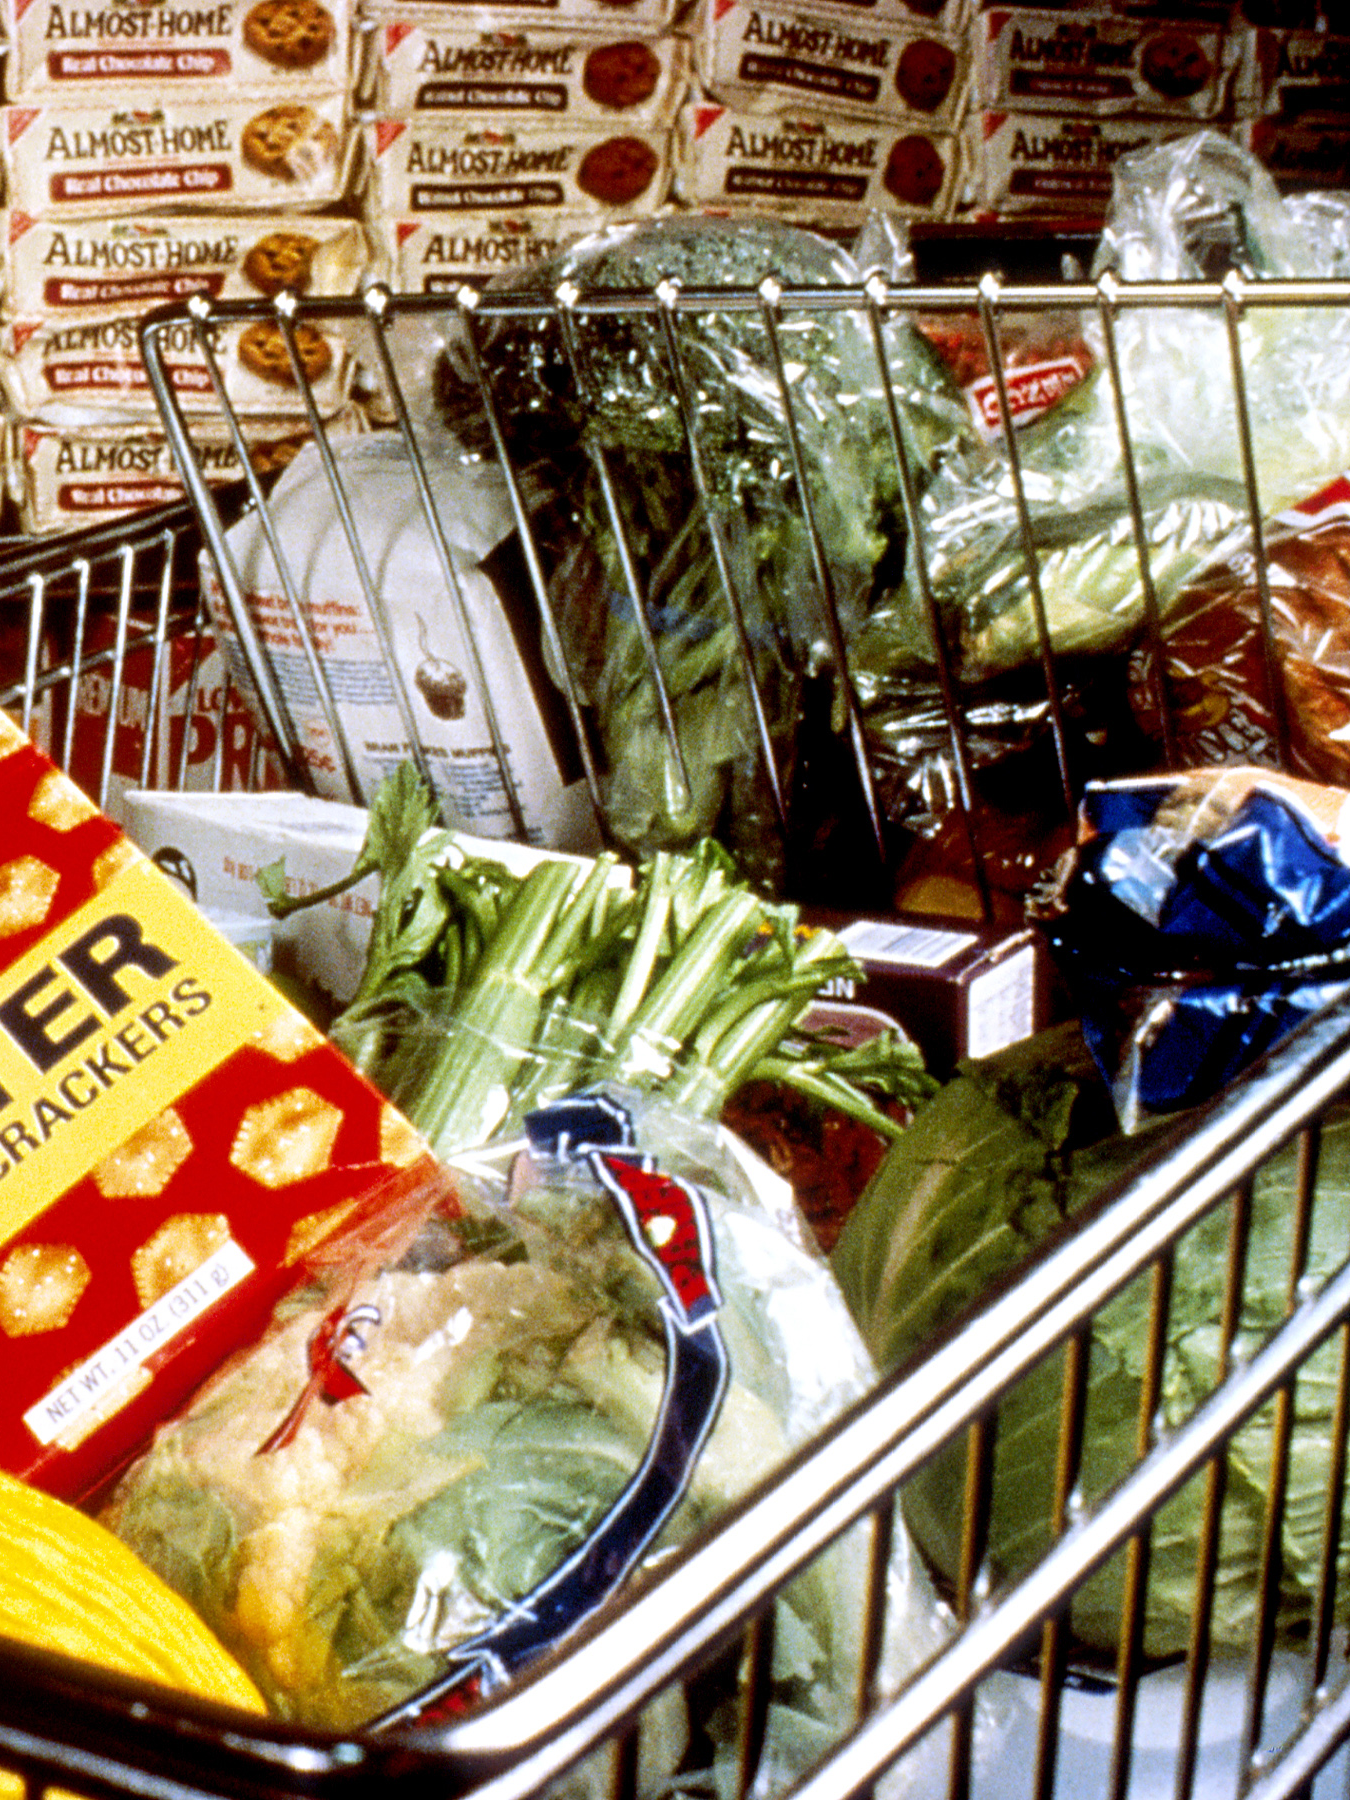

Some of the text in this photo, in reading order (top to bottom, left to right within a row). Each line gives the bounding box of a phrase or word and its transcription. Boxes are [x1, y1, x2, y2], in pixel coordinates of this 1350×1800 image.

[45, 4, 232, 38] ALMOST HOME
[743, 12, 828, 56] ALMOST
[176, 53, 216, 74] Chip
[45, 118, 232, 160] ALMOST HOME
[726, 125, 817, 165] ALMOST
[407, 141, 503, 174] ALMOST
[182, 170, 220, 192] Chip
[44, 231, 239, 268] ALMOST HOME
[423, 236, 514, 263] ALMOST
[44, 1387, 82, 1424] NET
[78, 1361, 117, 1394] WT.
[113, 1338, 140, 1365] 11
[168, 1279, 209, 1319] (311
[210, 1263, 231, 1288] g)
